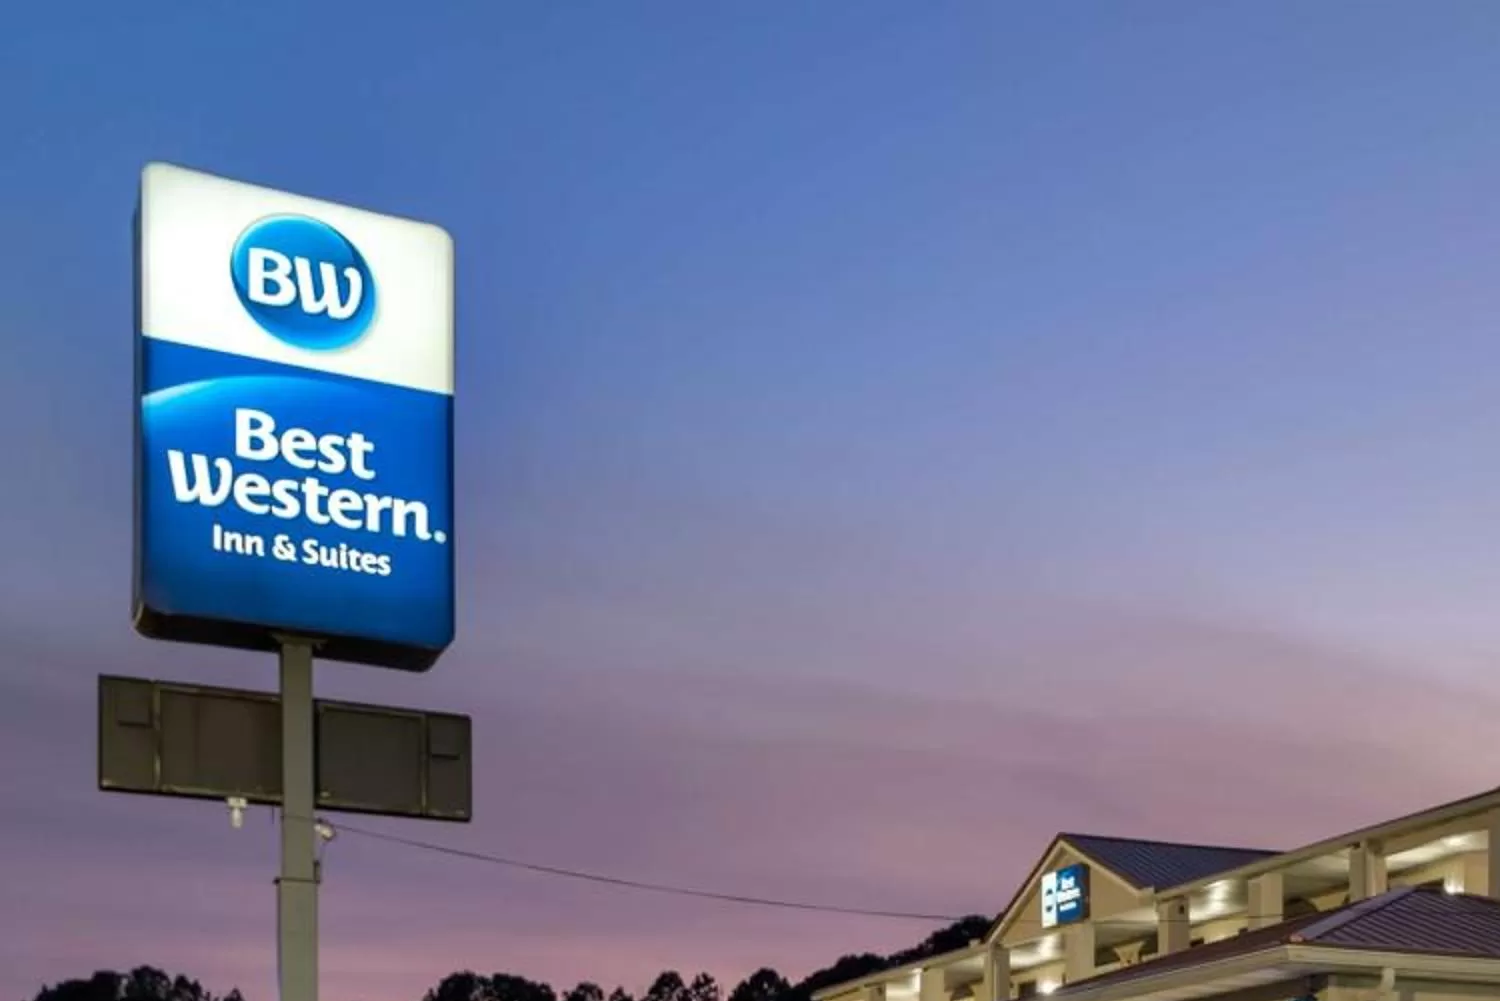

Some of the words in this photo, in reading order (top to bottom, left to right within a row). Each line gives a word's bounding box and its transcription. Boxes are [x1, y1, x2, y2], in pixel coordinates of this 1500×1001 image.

[247, 246, 363, 320] BW
[233, 407, 376, 480] Best
[212, 523, 265, 558] Inn
[271, 532, 297, 562] &
[301, 537, 391, 576] Suites
